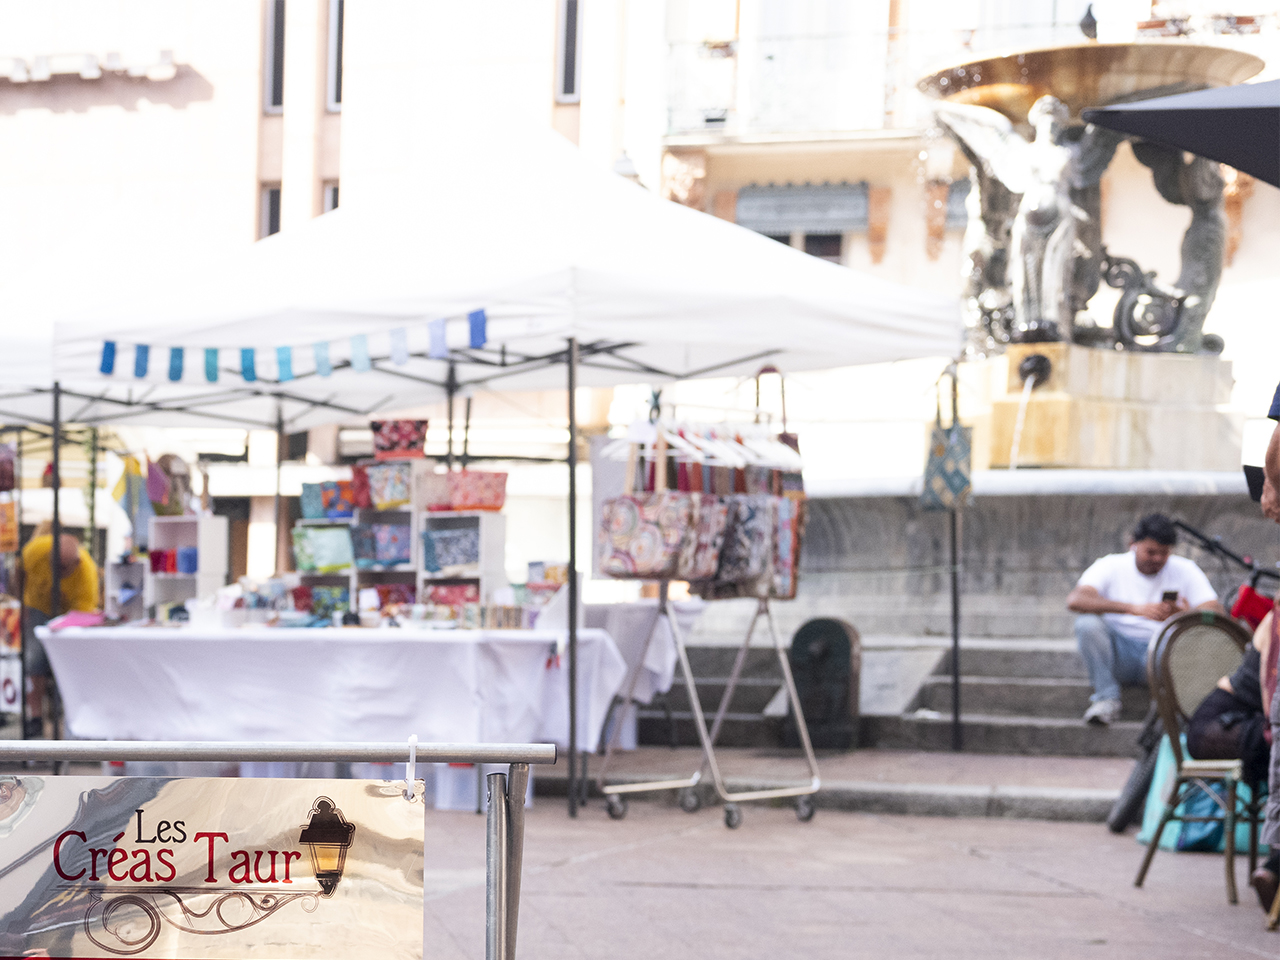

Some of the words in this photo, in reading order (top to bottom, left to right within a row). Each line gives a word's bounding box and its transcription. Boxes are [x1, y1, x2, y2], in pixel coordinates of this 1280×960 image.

[135, 809, 187, 843] Les
[53, 830, 177, 883] Créas
[193, 832, 302, 884] Taur
